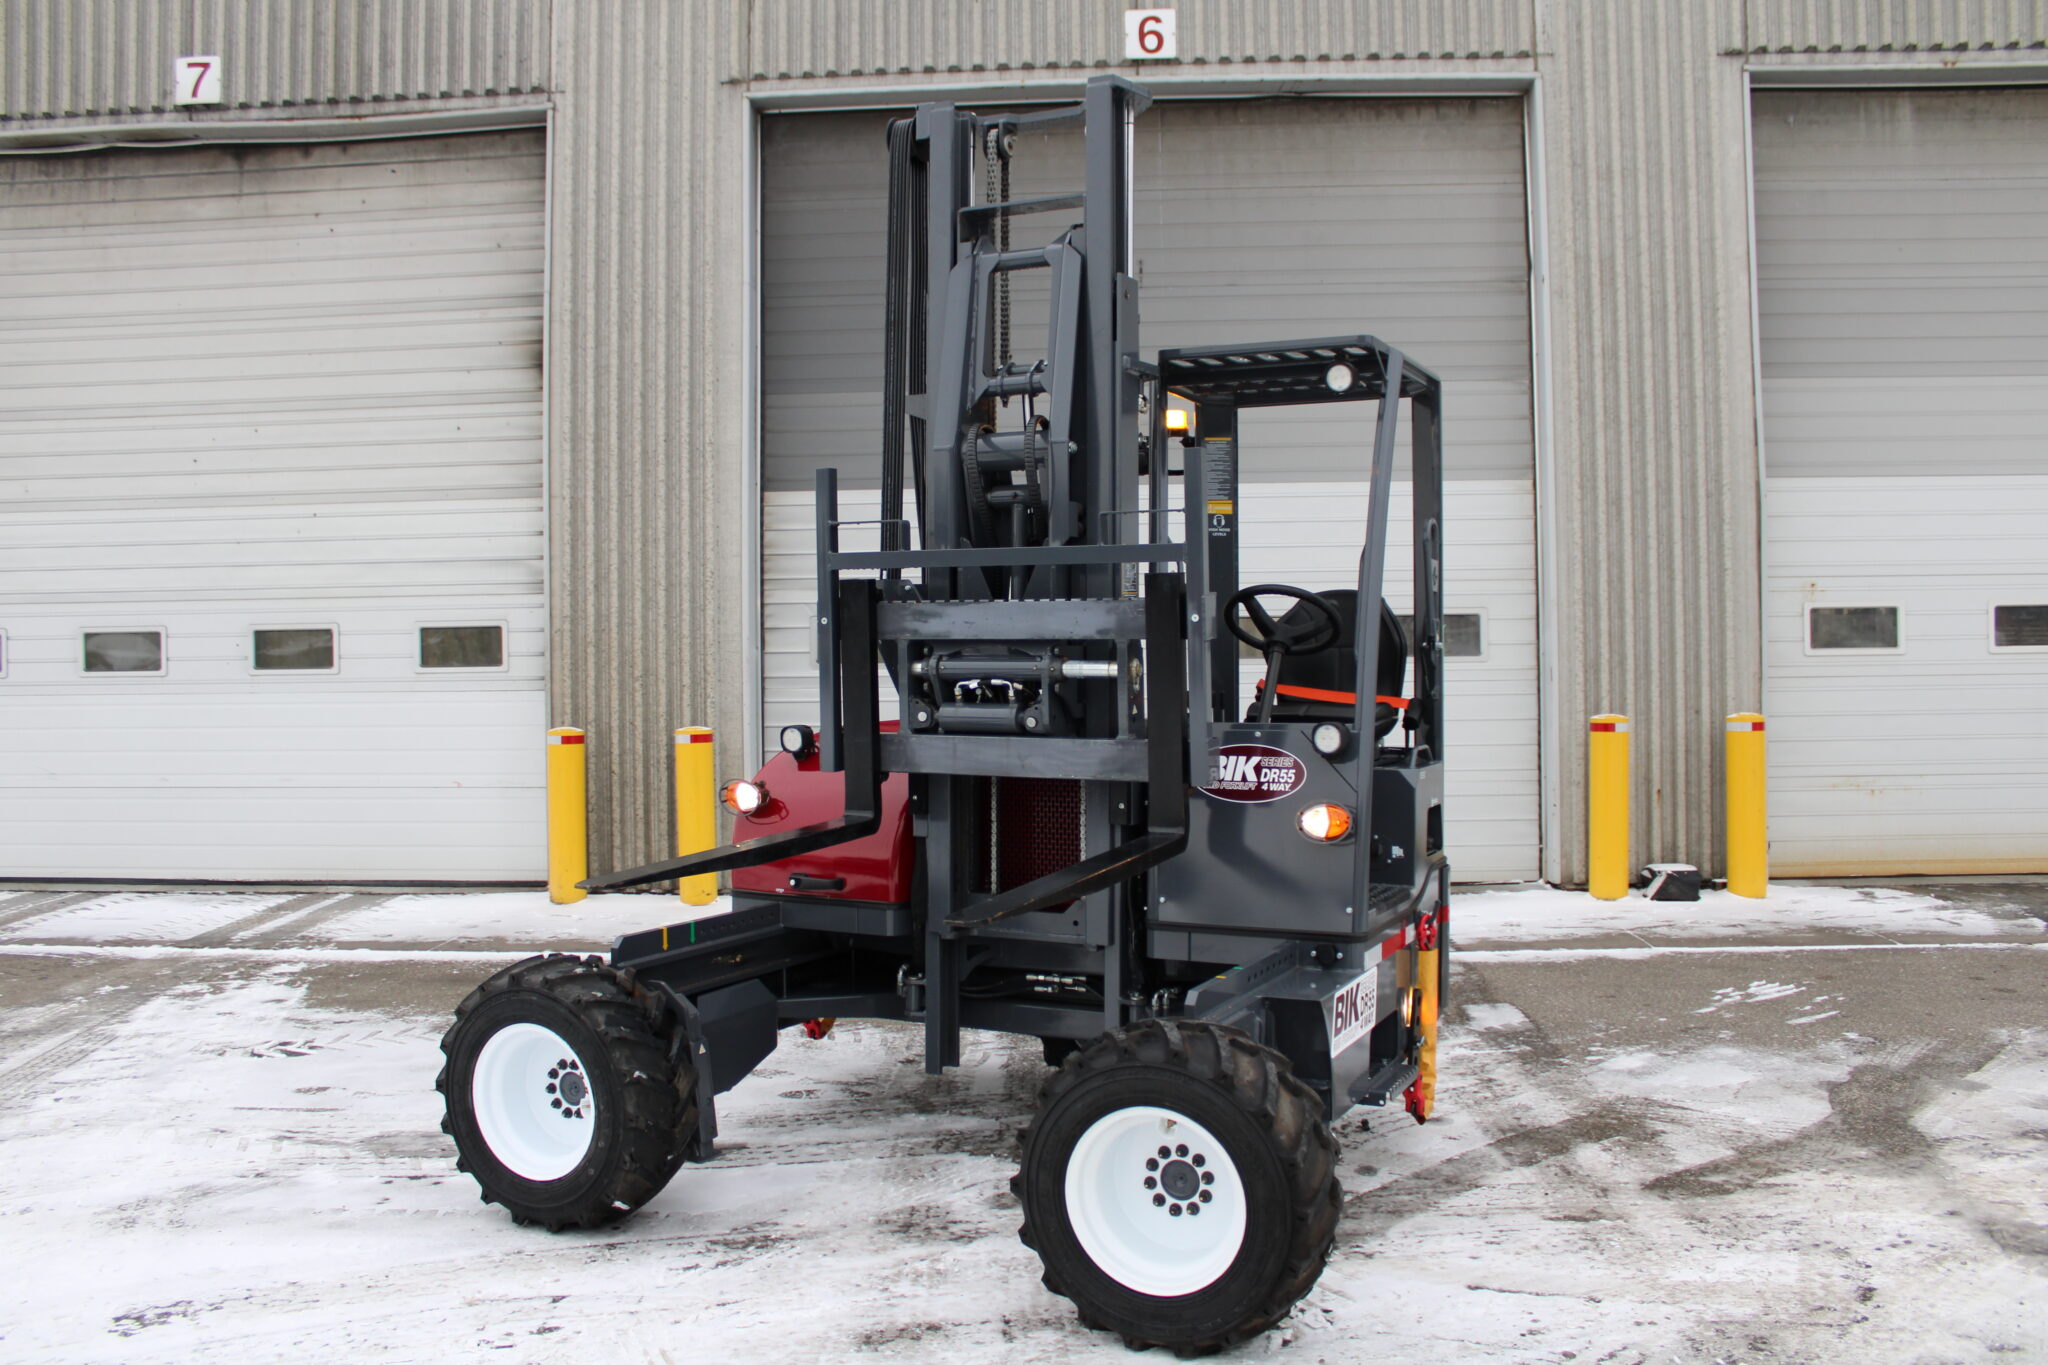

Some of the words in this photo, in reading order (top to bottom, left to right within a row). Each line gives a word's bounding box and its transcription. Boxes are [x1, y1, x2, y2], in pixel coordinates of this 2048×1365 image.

[1138, 15, 1164, 54] 6
[187, 62, 211, 98] 7
[1260, 756, 1294, 767] SERIES
[1260, 768, 1296, 782] DR55
[1261, 782, 1269, 791] 4
[1333, 982, 1361, 1038] BIK
